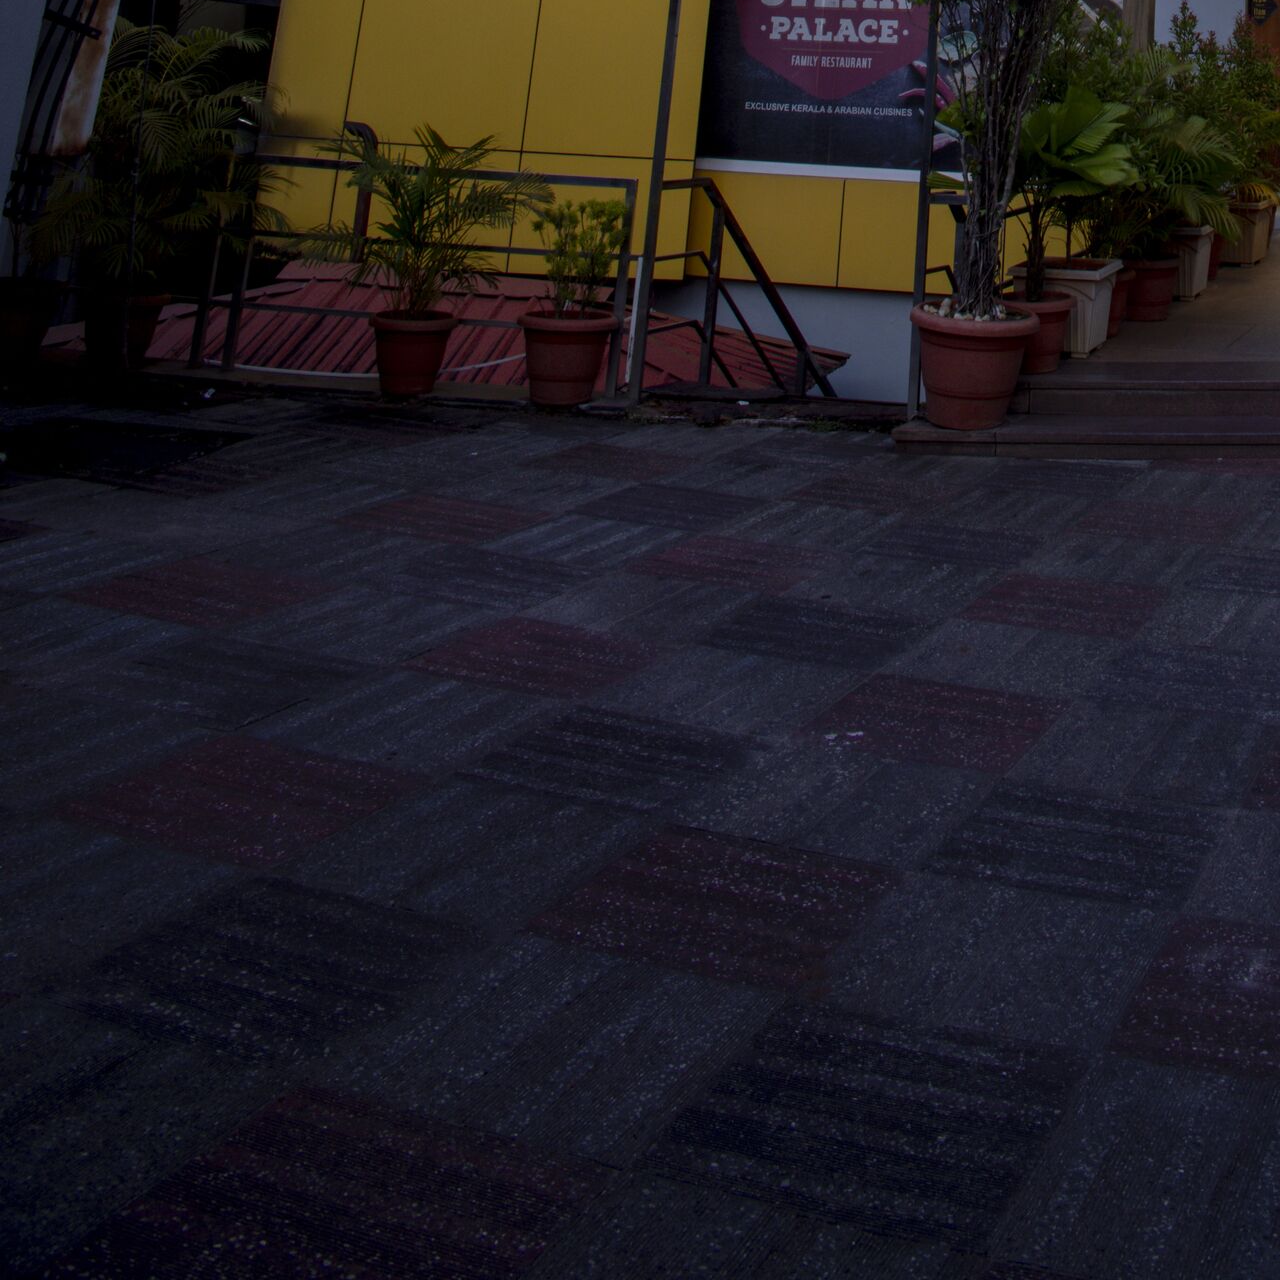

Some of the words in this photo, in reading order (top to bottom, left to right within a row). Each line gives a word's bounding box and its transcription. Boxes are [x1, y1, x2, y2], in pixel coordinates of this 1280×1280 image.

[769, 16, 899, 44] PALACE
[791, 55, 819, 67] FAMILY
[821, 56, 873, 69] RESTAURANT
[745, 101, 790, 112] EXCLUSIVE
[791, 103, 826, 113] KERALA
[827, 105, 833, 114] &
[833, 105, 872, 115] ARABIAN
[873, 107, 913, 117] CUISINES
